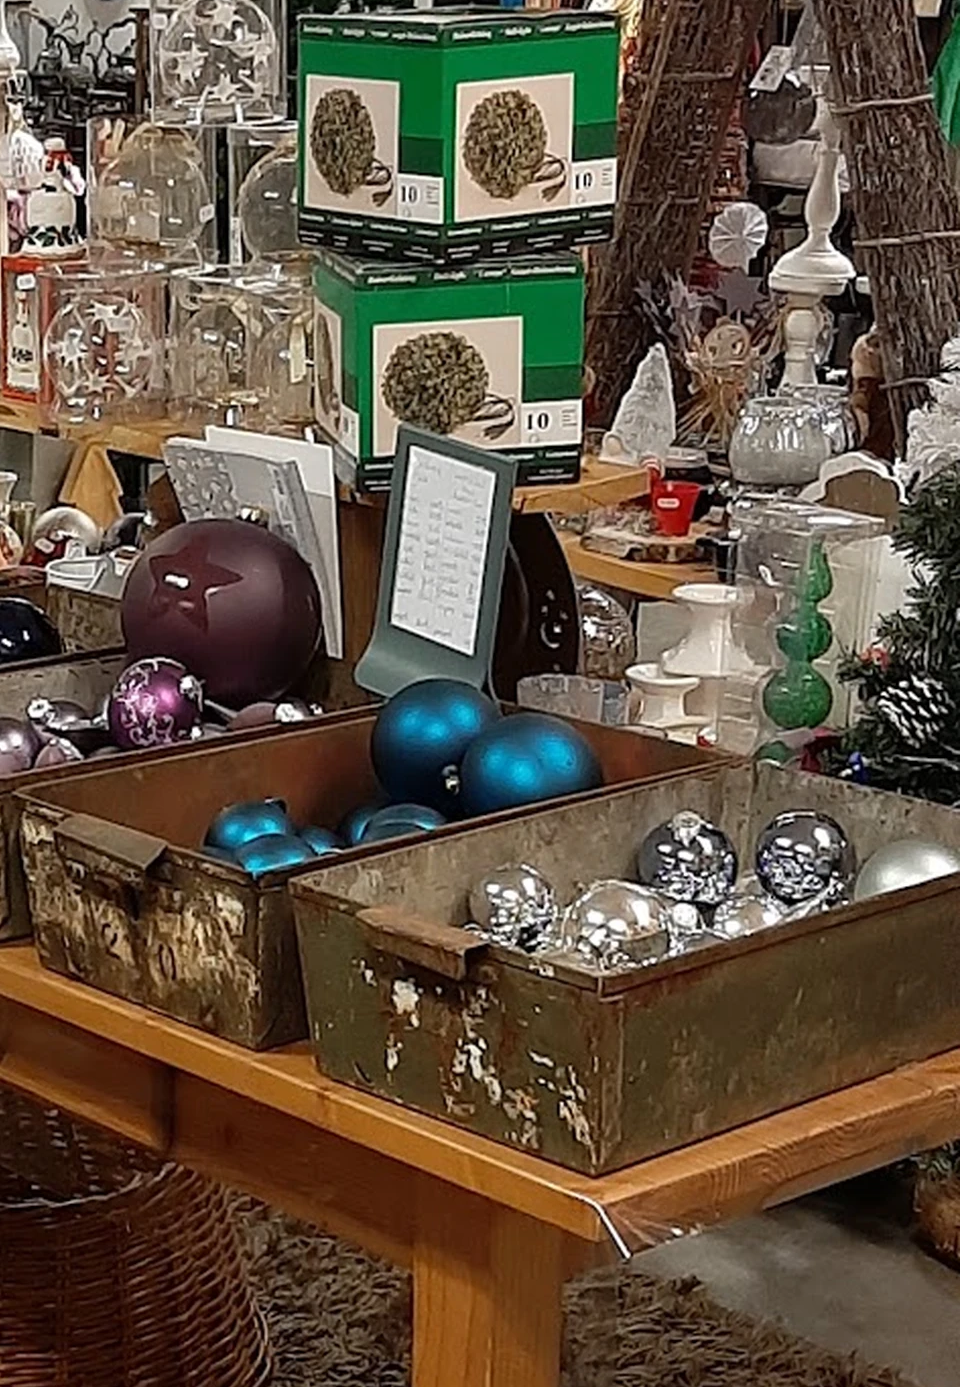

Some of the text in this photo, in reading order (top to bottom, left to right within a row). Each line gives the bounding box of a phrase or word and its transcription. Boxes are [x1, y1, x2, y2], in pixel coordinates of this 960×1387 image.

[575, 172, 594, 191] 10
[400, 185, 418, 203] 10
[526, 412, 550, 431] 10
